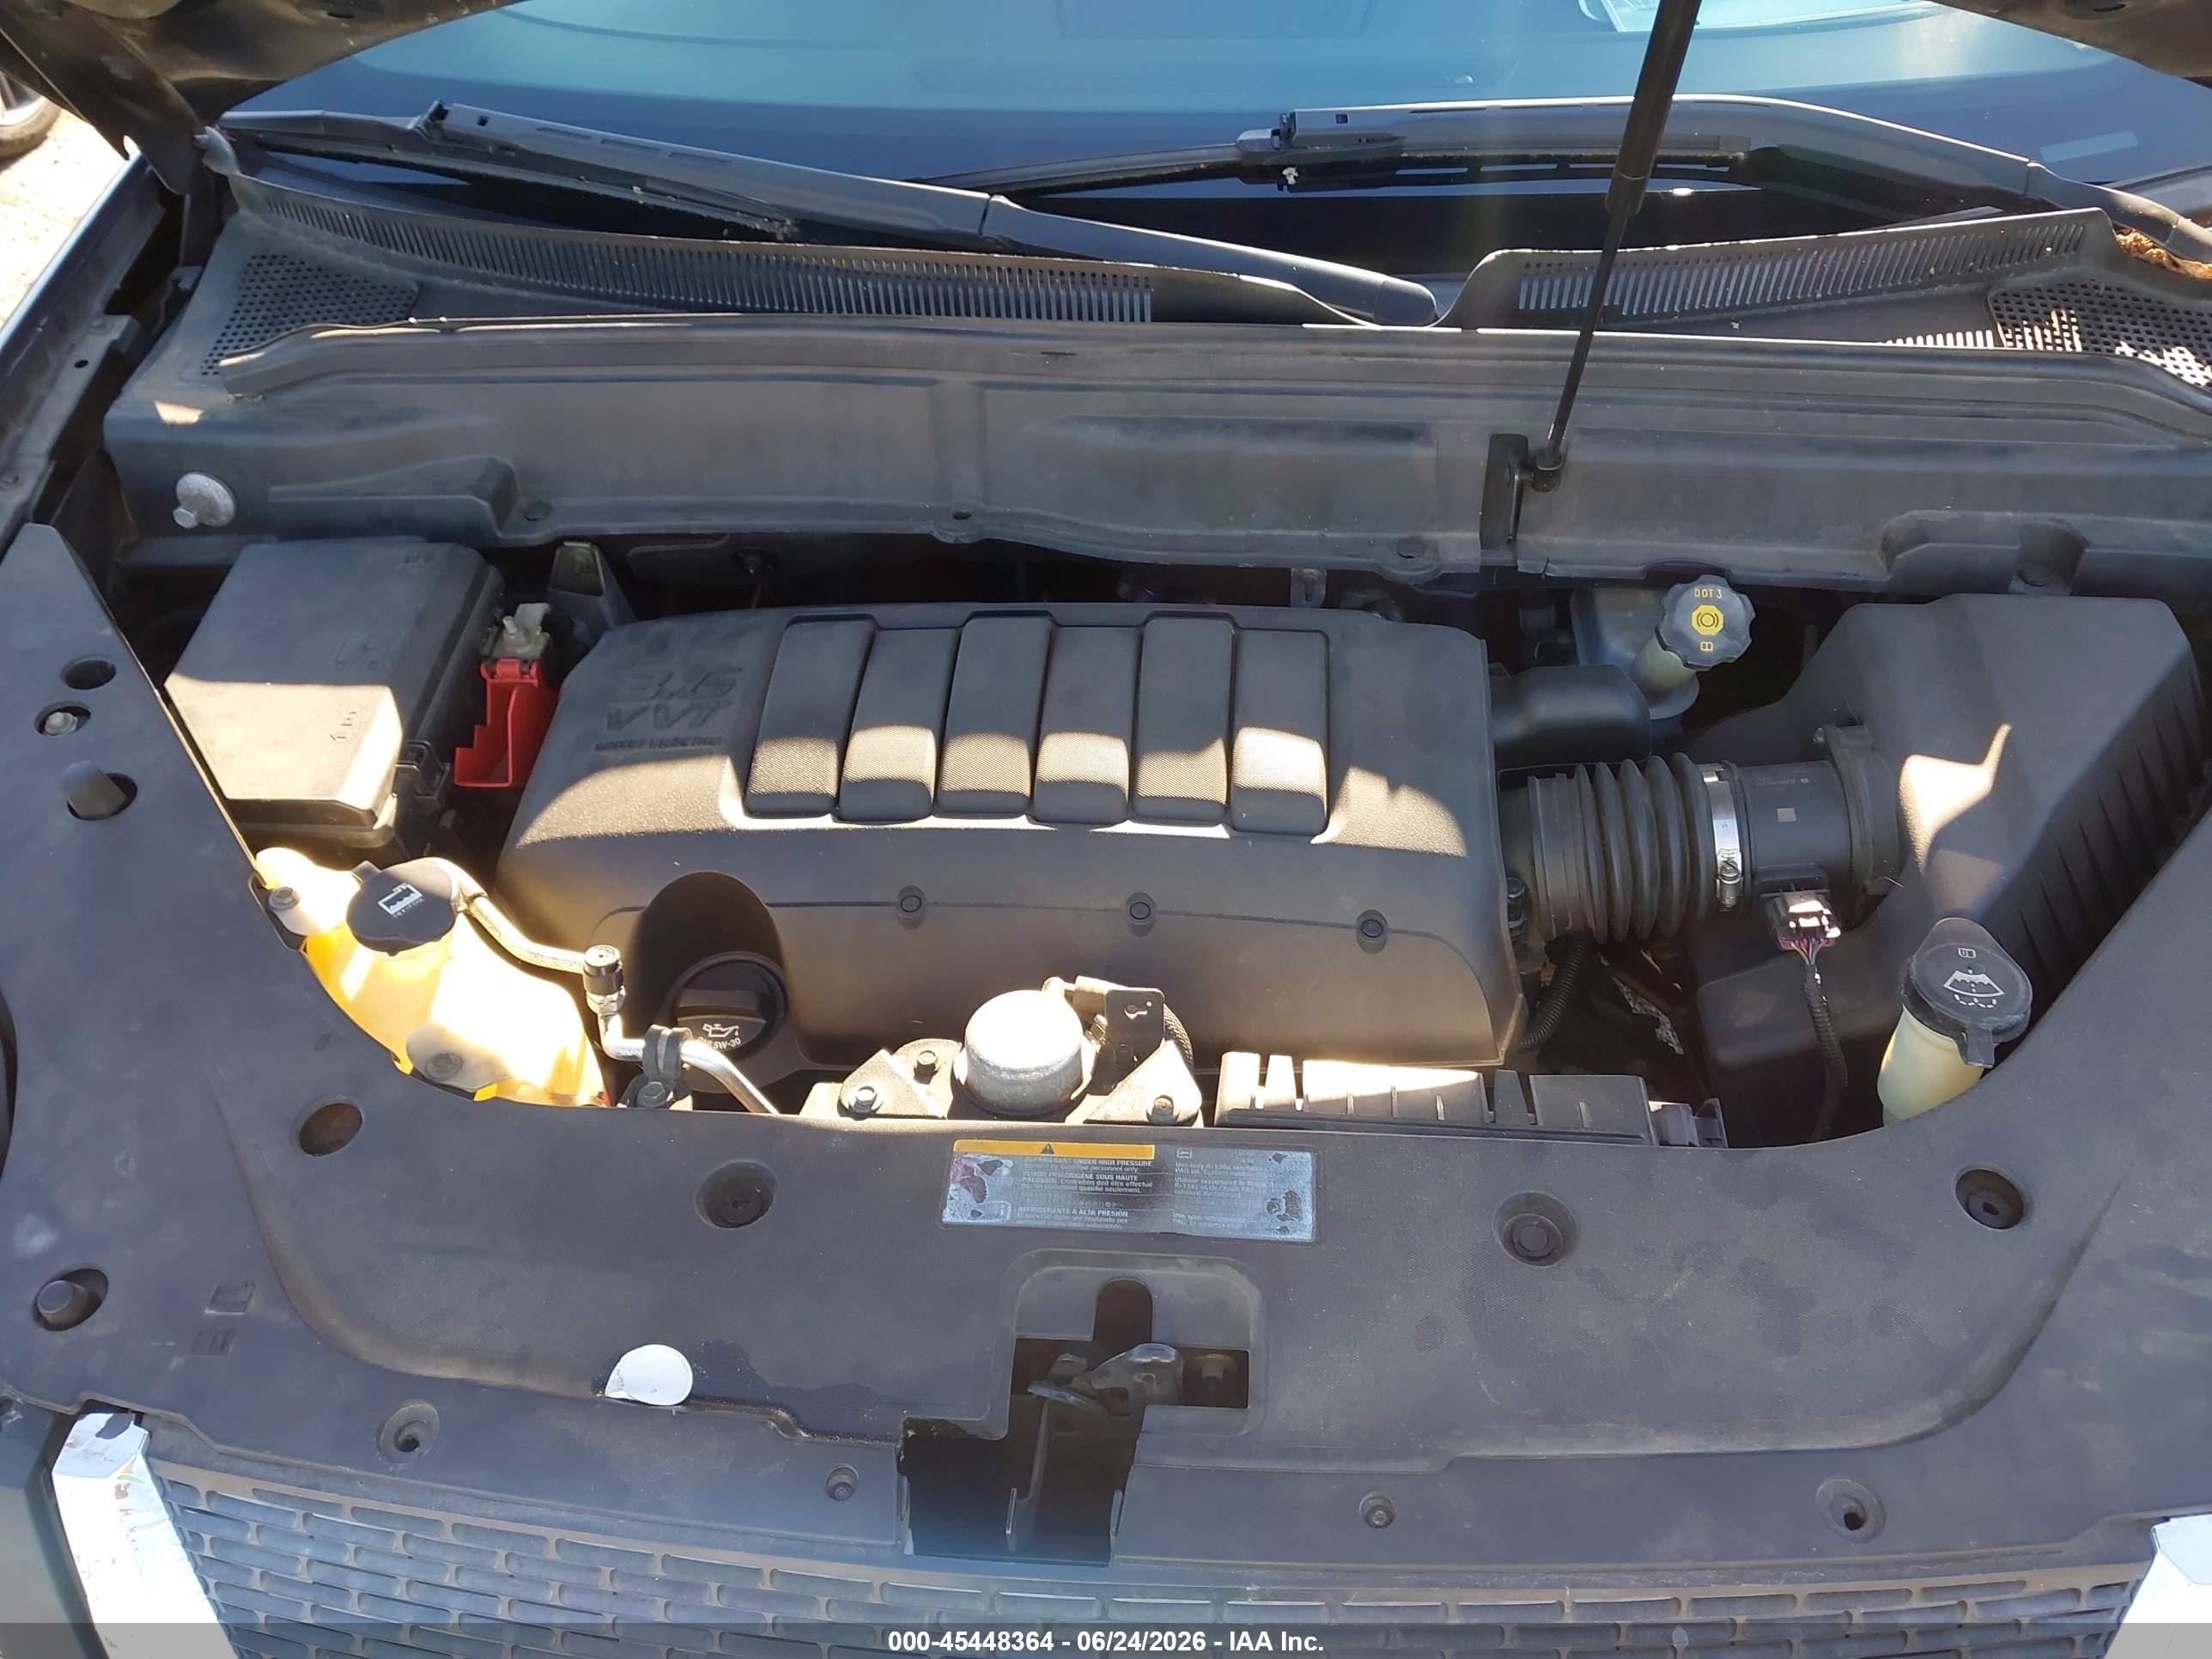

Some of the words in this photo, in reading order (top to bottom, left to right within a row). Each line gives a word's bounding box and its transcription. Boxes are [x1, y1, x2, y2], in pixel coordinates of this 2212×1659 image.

[1694, 588, 1714, 598] DOT
[1717, 589, 1723, 599] 3
[713, 1037, 741, 1049] 5W-30
